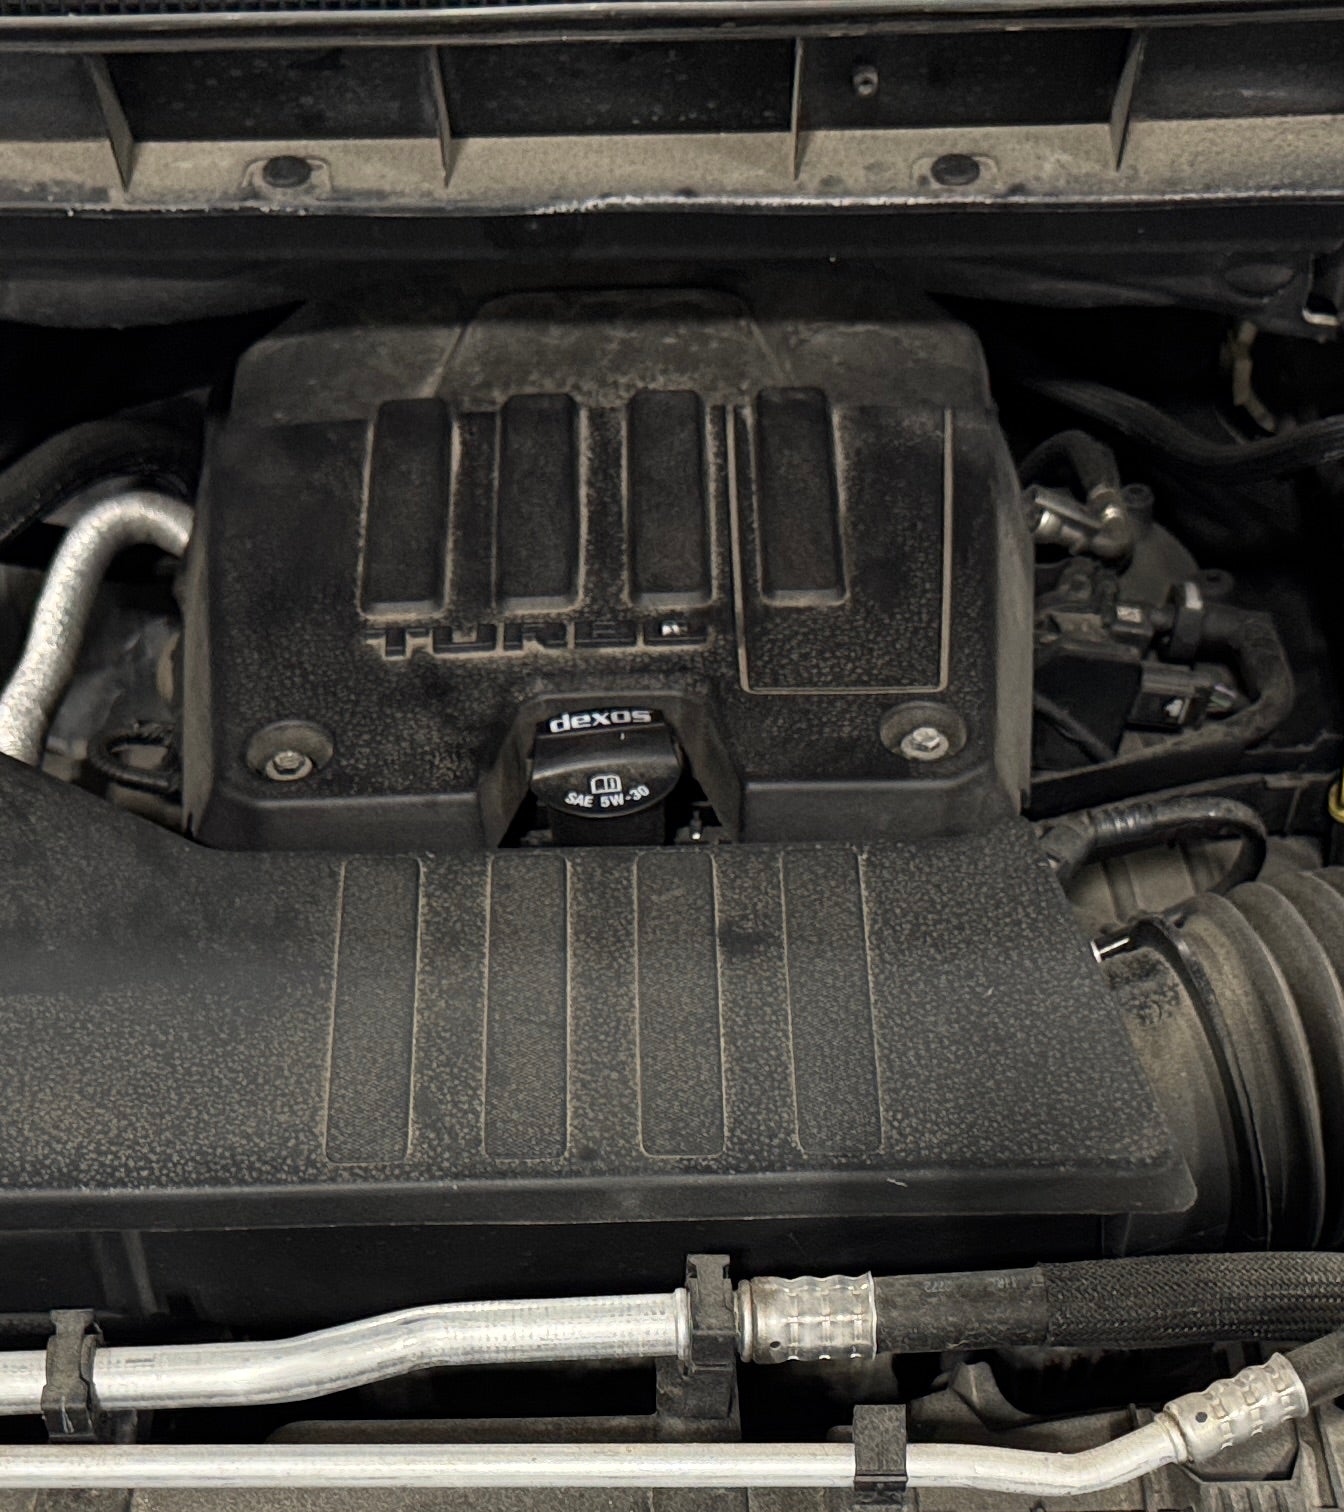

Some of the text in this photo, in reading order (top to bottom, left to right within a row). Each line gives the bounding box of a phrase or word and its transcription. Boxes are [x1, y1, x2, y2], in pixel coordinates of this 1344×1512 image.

[549, 710, 652, 733] dexos
[564, 784, 650, 808] SAE 5W-30
